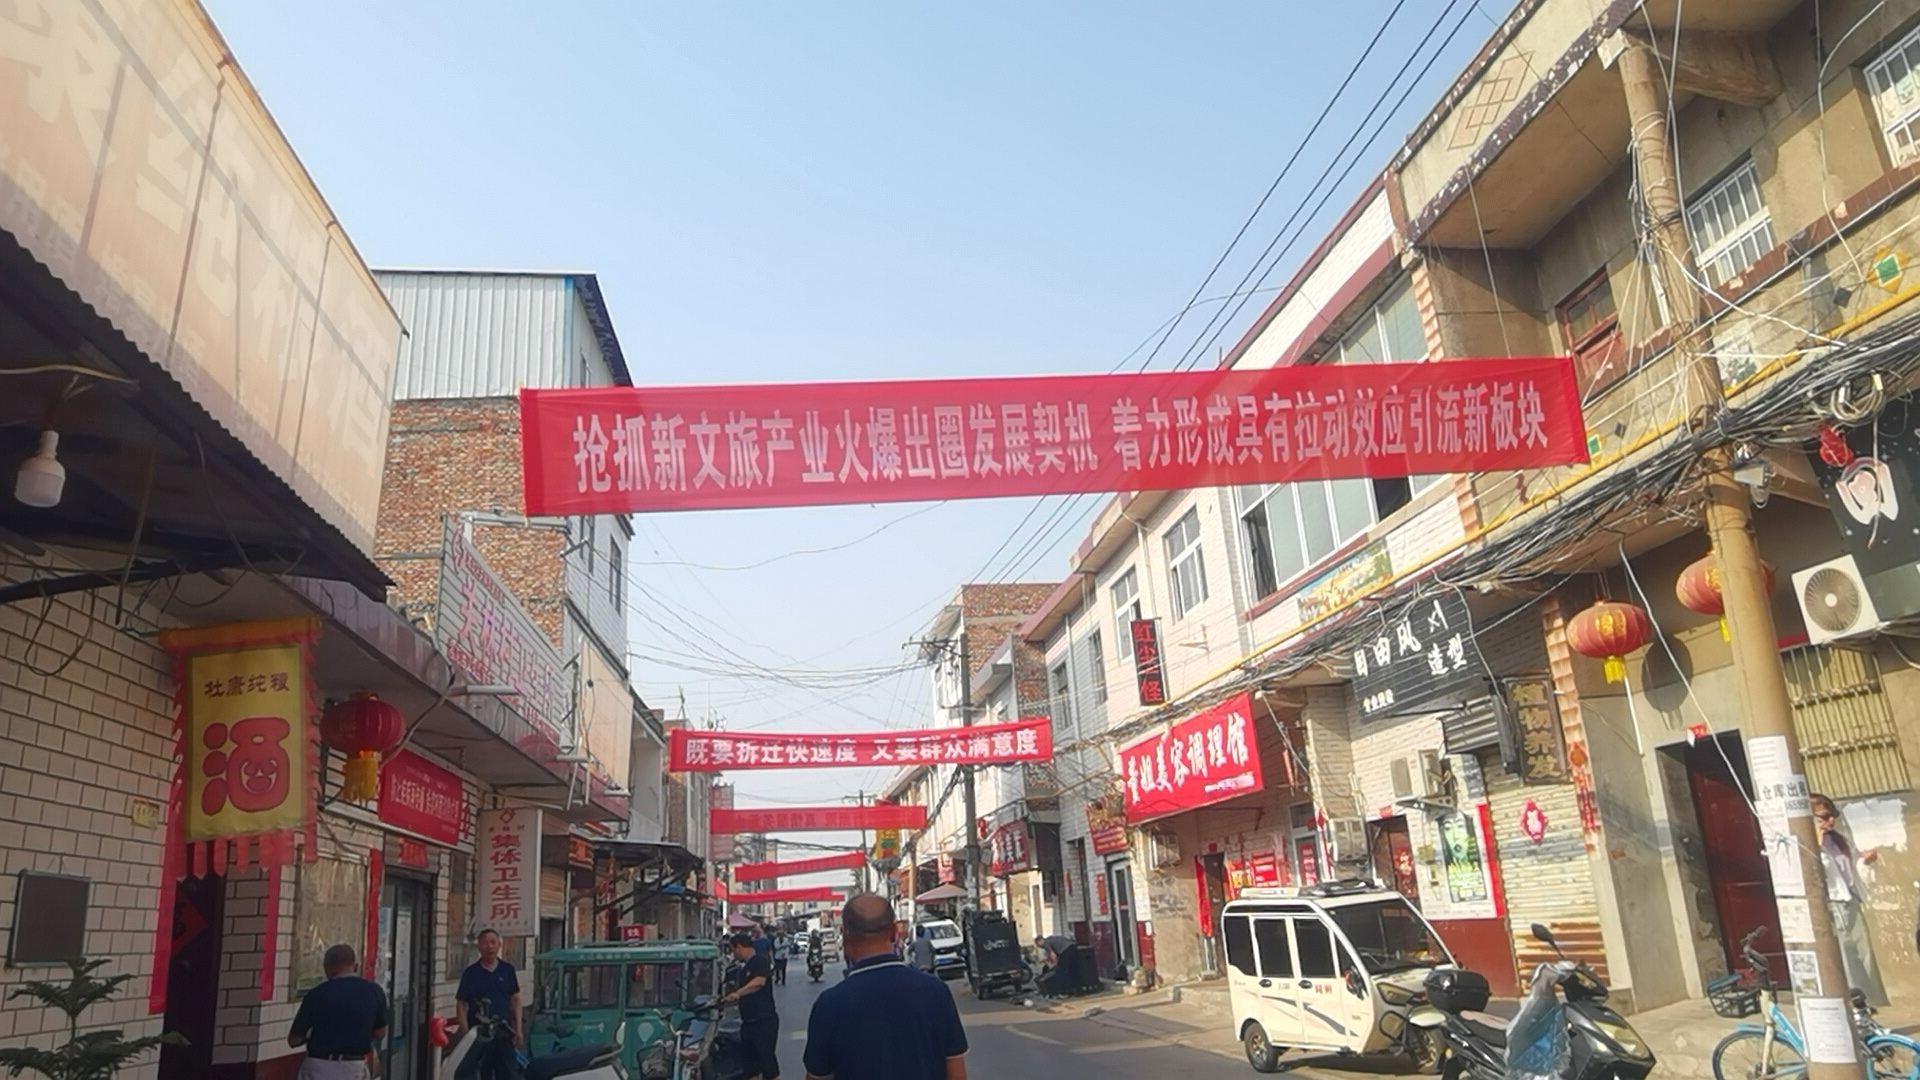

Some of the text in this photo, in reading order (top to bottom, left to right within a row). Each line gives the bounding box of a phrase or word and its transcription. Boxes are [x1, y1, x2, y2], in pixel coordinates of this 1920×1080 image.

[573, 380, 1548, 494] 抢抓新文旅产业火爆出圈发展契机 着力形成具有拉动效应引流新板块
[201, 716, 291, 816] 酒
[685, 728, 1039, 765] 既要拆迁快速度 又要群众满意度
[1512, 683, 1561, 779] 植物养发
[489, 833, 522, 921] 集体卫生所
